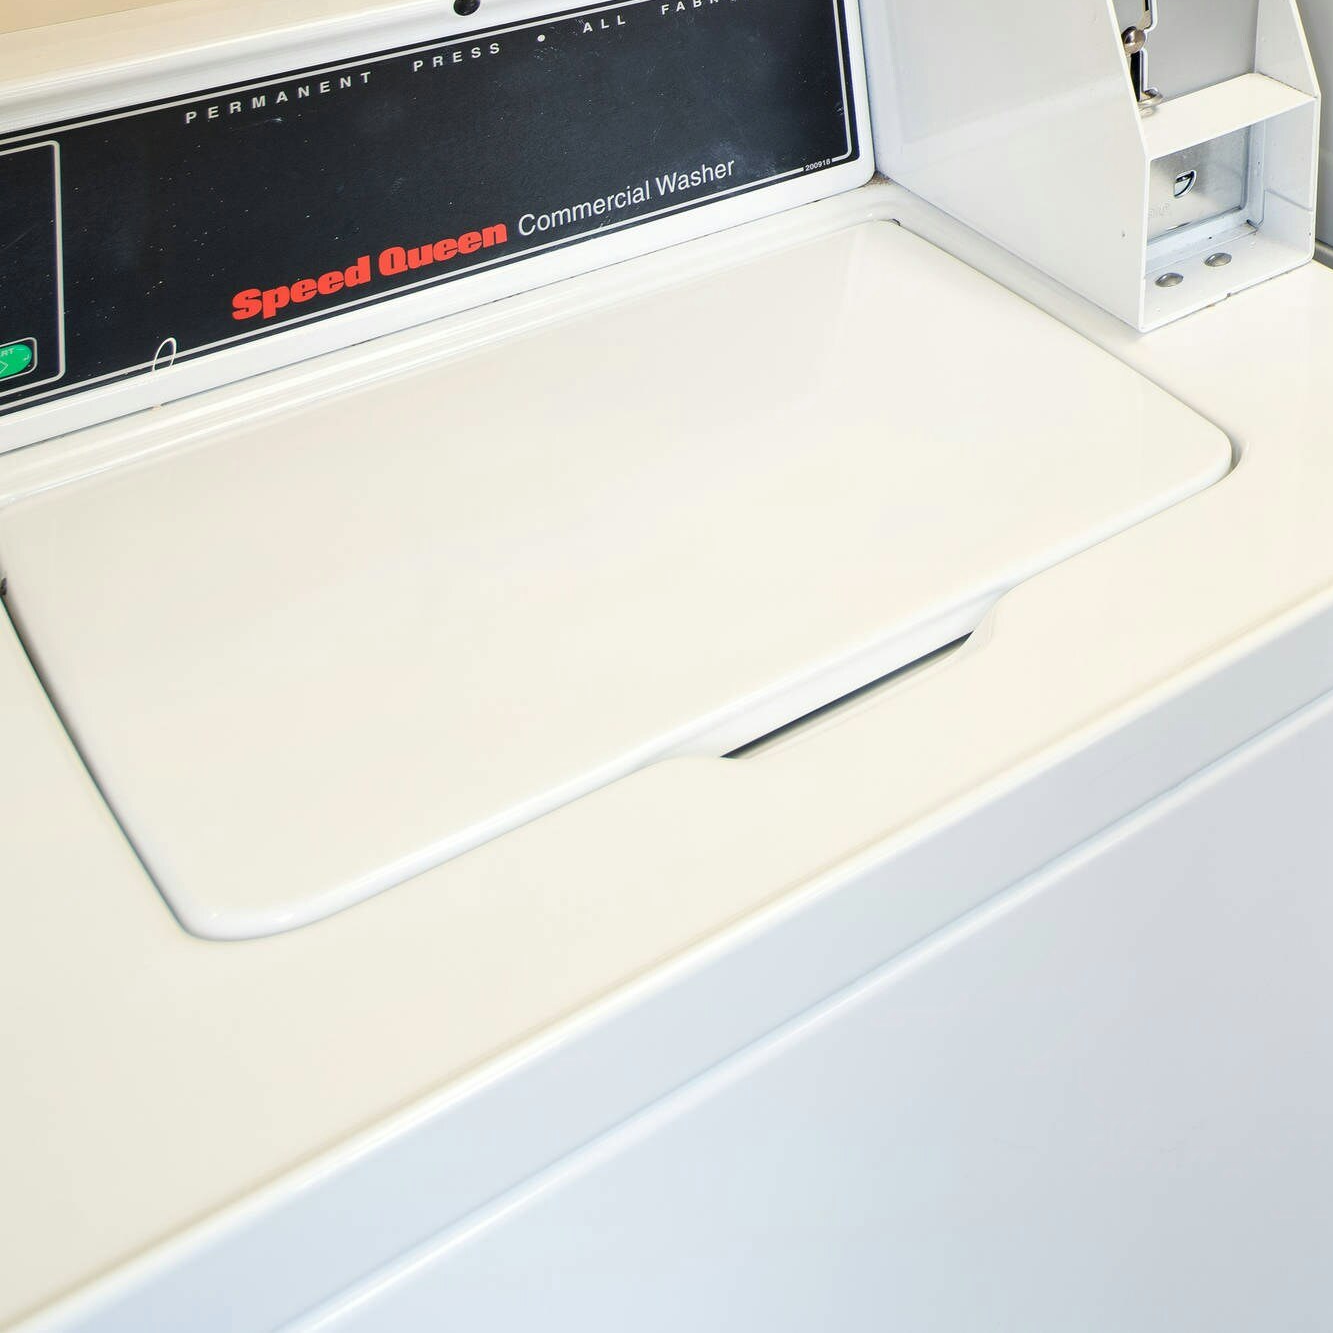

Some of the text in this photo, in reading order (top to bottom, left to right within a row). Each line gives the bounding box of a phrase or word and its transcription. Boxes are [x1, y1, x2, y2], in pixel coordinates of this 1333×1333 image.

[185, 71, 372, 125] PERMANENT
[413, 42, 500, 73] PRESS
[582, 15, 626, 34] ALL
[231, 160, 735, 321] Speed Queen Commercial Washer
